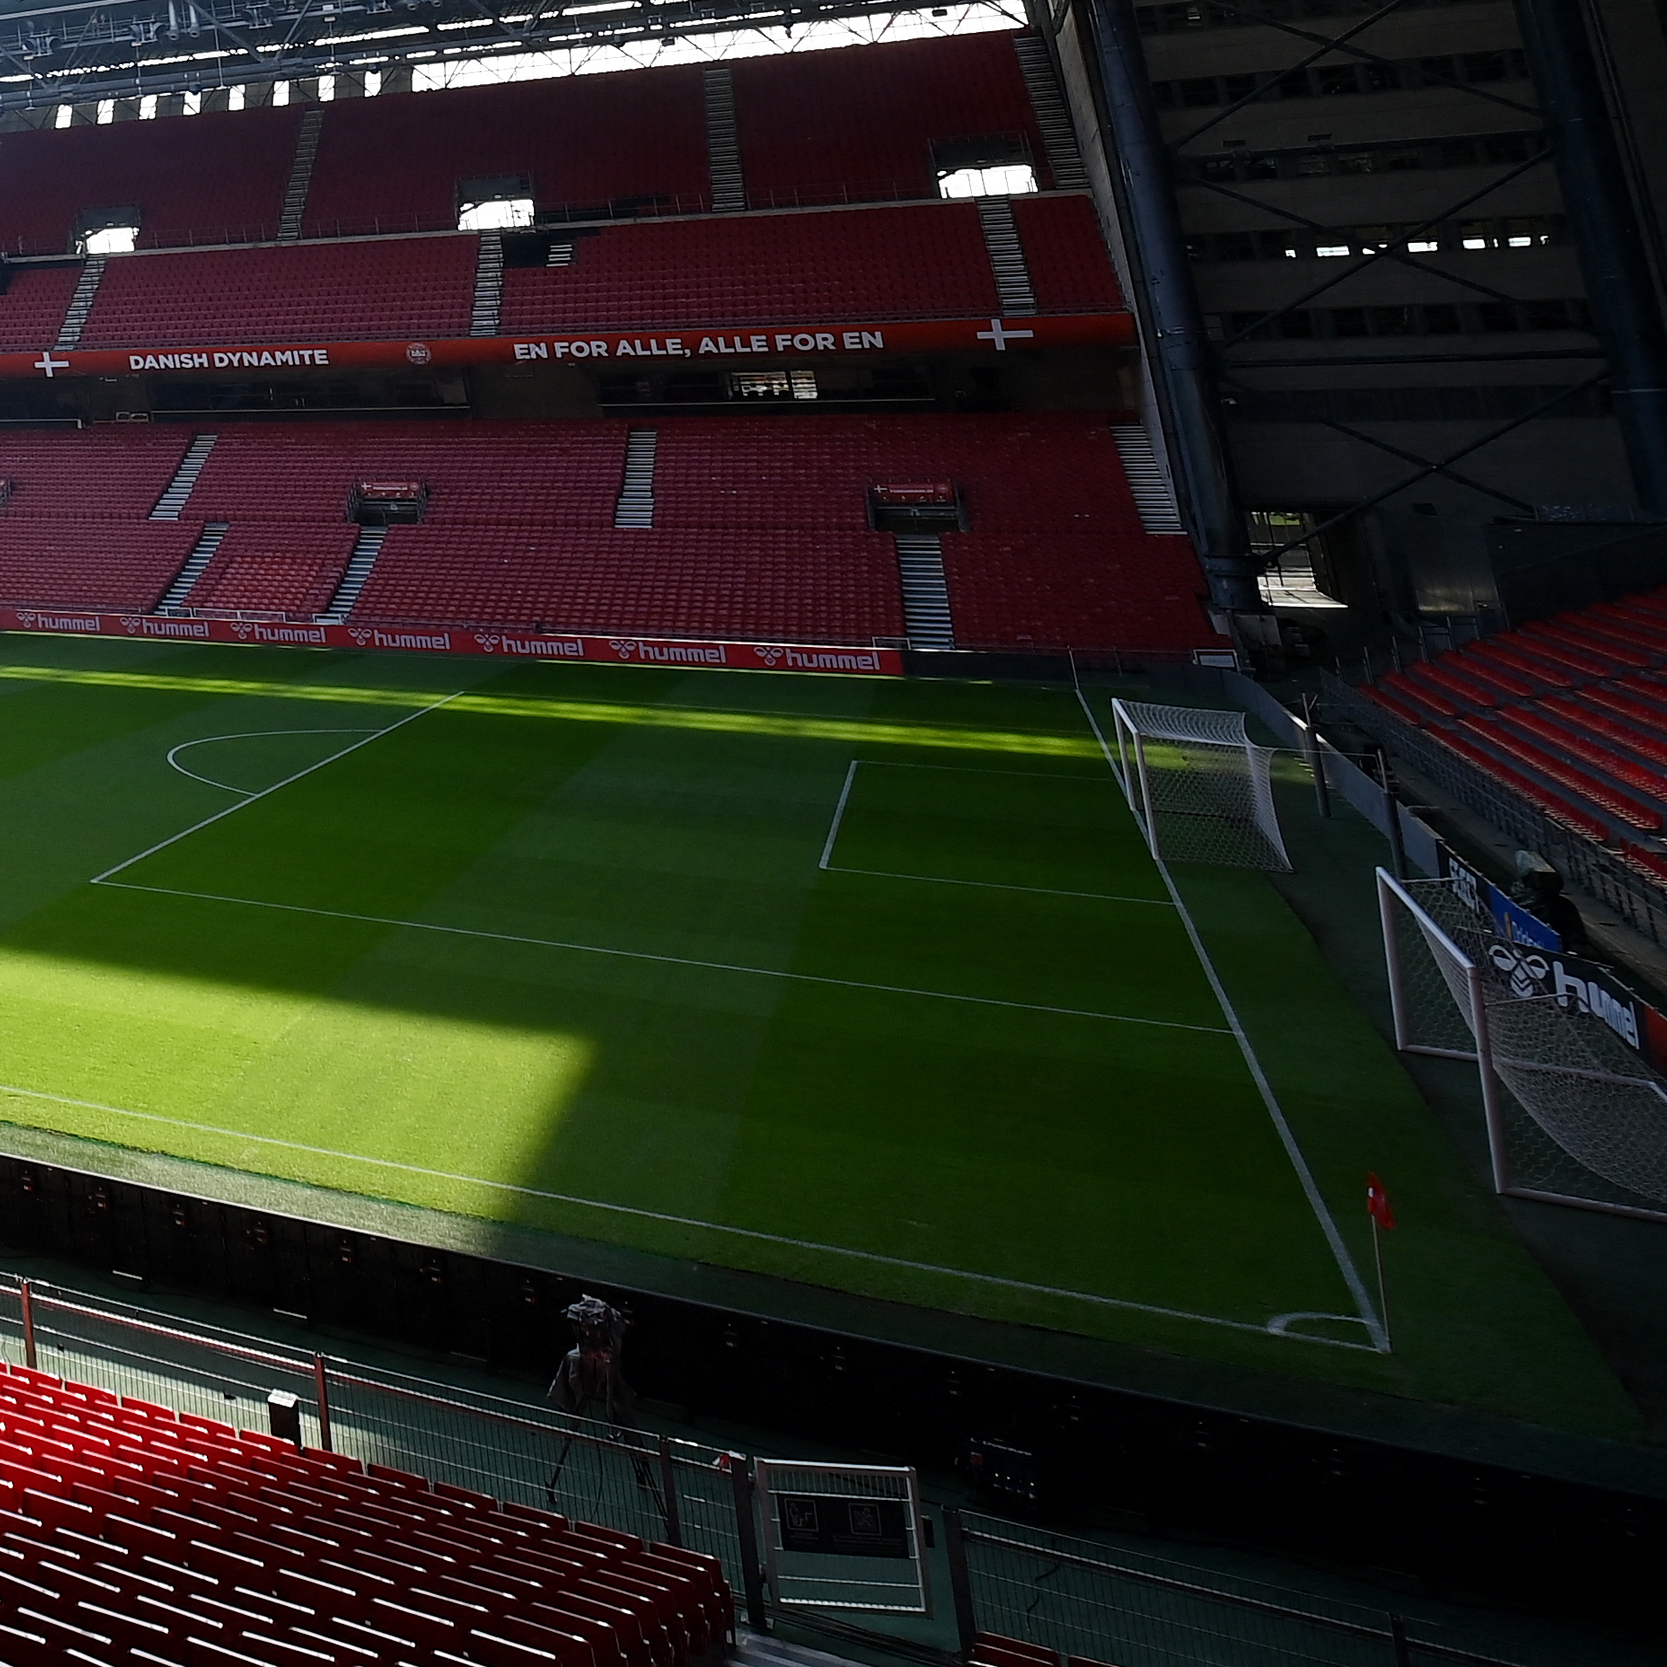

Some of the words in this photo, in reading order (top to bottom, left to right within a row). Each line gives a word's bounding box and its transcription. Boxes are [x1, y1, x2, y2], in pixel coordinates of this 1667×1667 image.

[513, 343, 548, 360] EN
[554, 340, 608, 359] FOR
[615, 337, 692, 358] ALLE,
[698, 335, 769, 354] ALLE
[776, 332, 836, 351] FOR
[842, 331, 884, 349] EN
[129, 352, 209, 371] DANISH
[213, 349, 329, 369] DYNAMITE
[37, 616, 100, 632] hummel
[142, 621, 209, 637] hummel
[254, 625, 326, 643] hummel
[374, 629, 450, 650] hummel
[502, 635, 584, 656] hummel
[638, 641, 726, 663] hummel
[786, 648, 880, 670] hummel
[1553, 961, 1641, 1050] hummel
